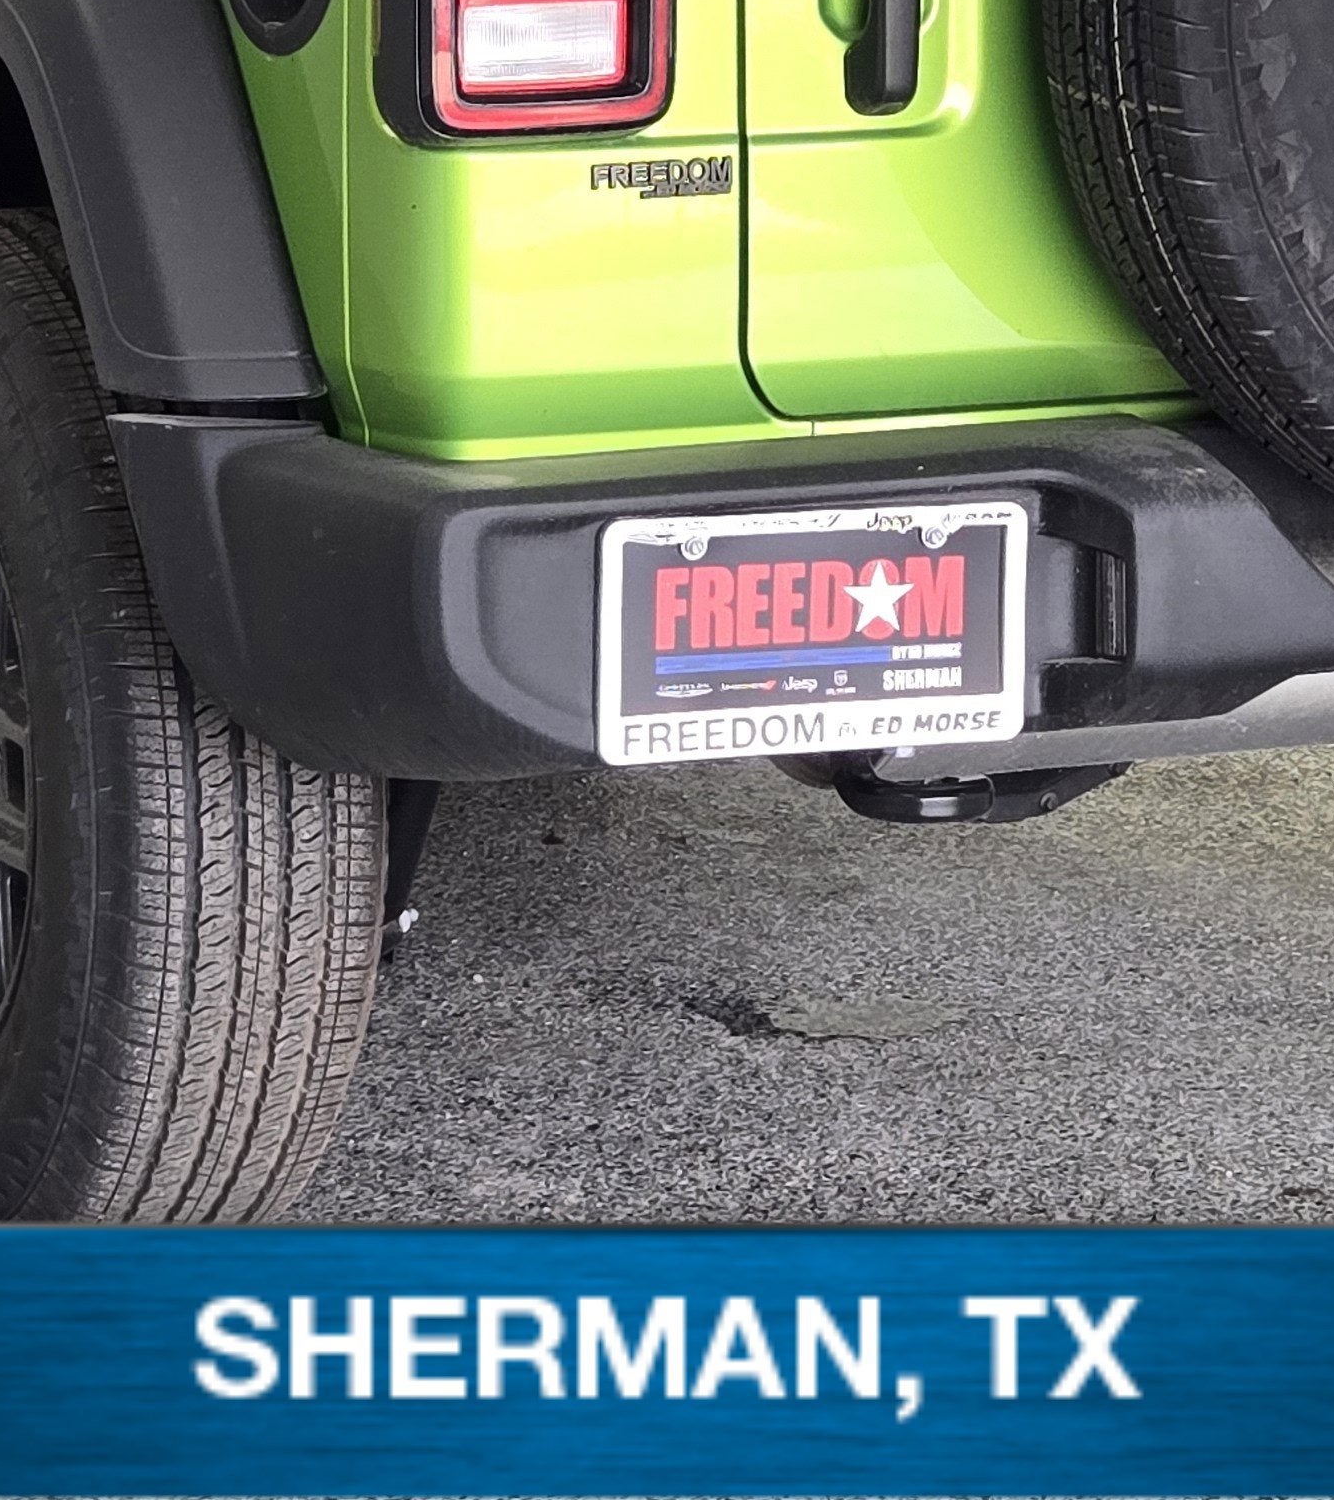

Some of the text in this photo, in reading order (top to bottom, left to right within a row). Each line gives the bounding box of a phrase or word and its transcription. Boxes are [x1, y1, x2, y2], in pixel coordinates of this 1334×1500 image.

[591, 155, 733, 191] FREEDOM
[623, 711, 825, 756] FREEDOM
[870, 715, 903, 736] ED
[913, 710, 1002, 733] MORSE
